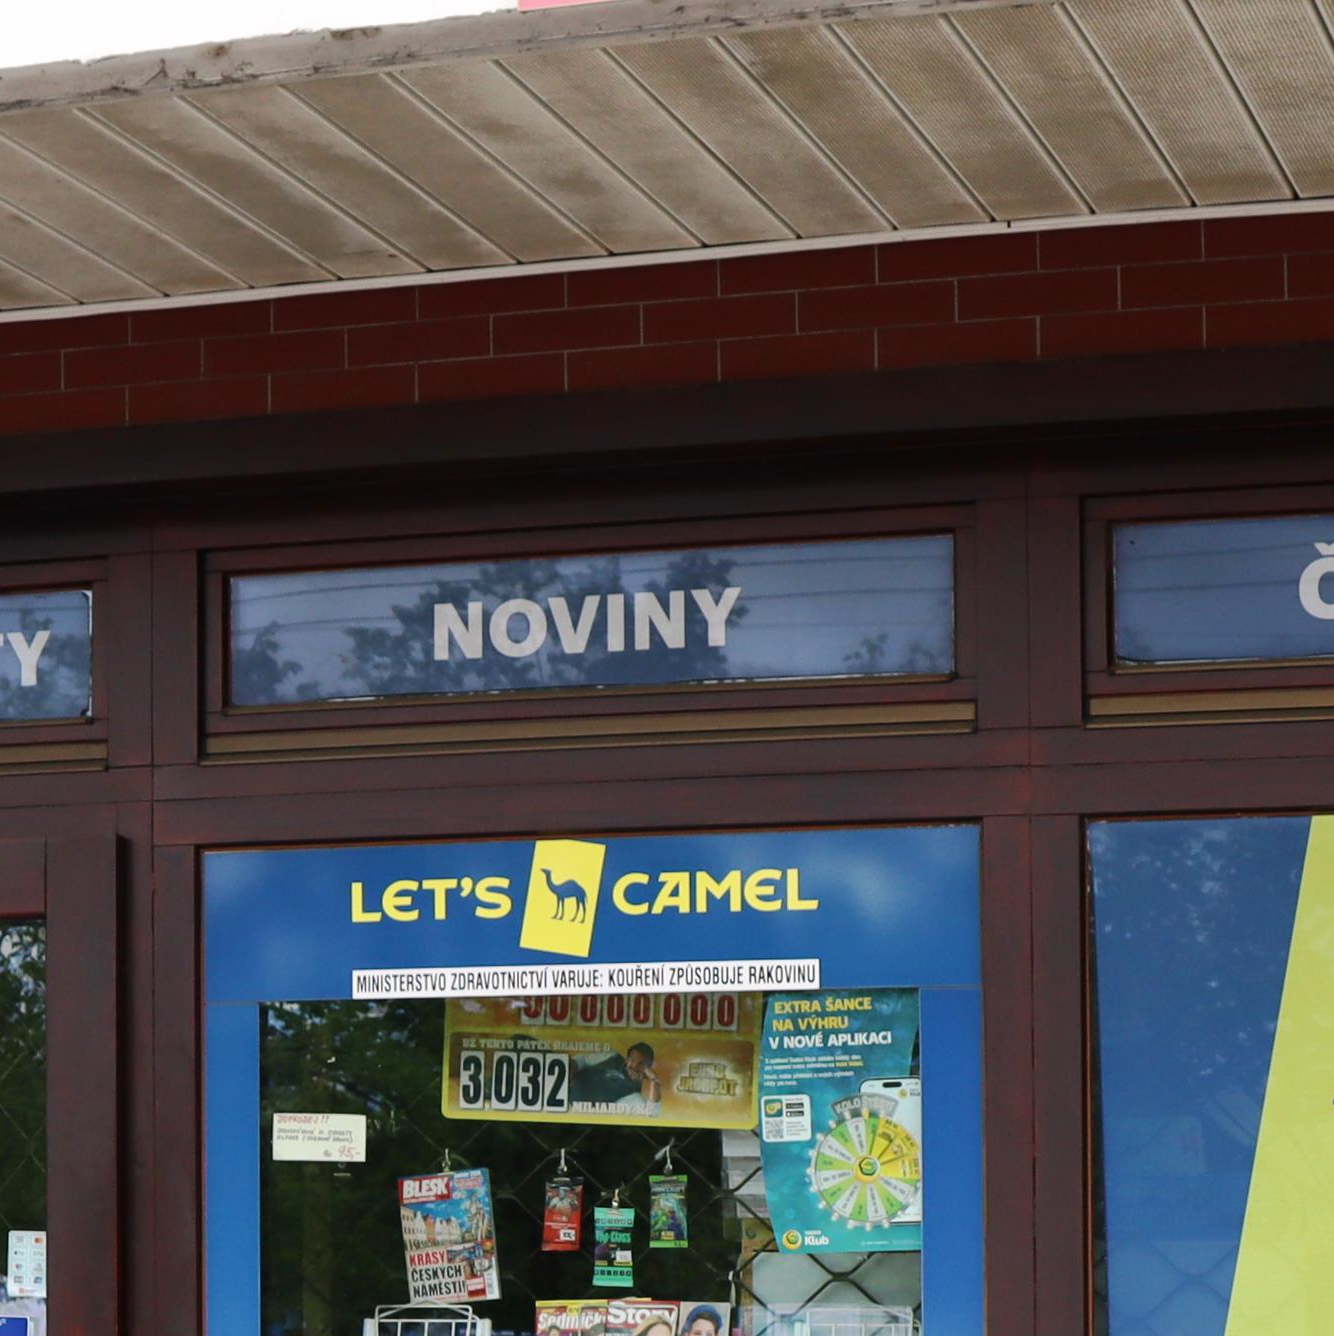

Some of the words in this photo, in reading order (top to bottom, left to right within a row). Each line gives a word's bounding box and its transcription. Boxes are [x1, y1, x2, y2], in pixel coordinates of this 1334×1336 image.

[433, 586, 742, 661] NOVINY
[350, 876, 512, 924] LET'S
[611, 867, 820, 916] CAMEL
[355, 972, 447, 994] MINISTERSTVO
[450, 966, 549, 991] ZDRAVOTNICTVÍ
[551, 968, 604, 989] VARUJE:
[608, 963, 666, 987] KOUŘENÍ
[669, 962, 745, 987] ZPŮSOBUJE
[748, 963, 817, 984] RAKOVINU
[774, 1000, 822, 1015] EXTRA
[825, 996, 873, 1012] ŠANCE
[772, 1019, 794, 1032] NA
[797, 1014, 849, 1031] VÝHRU
[769, 1036, 779, 1050] V
[783, 1031, 824, 1049] NOVÉ
[827, 1031, 893, 1047] APLIKACI
[403, 1177, 449, 1199] BLESK
[804, 1234, 830, 1246] Klub
[409, 1251, 446, 1268] KRASY
